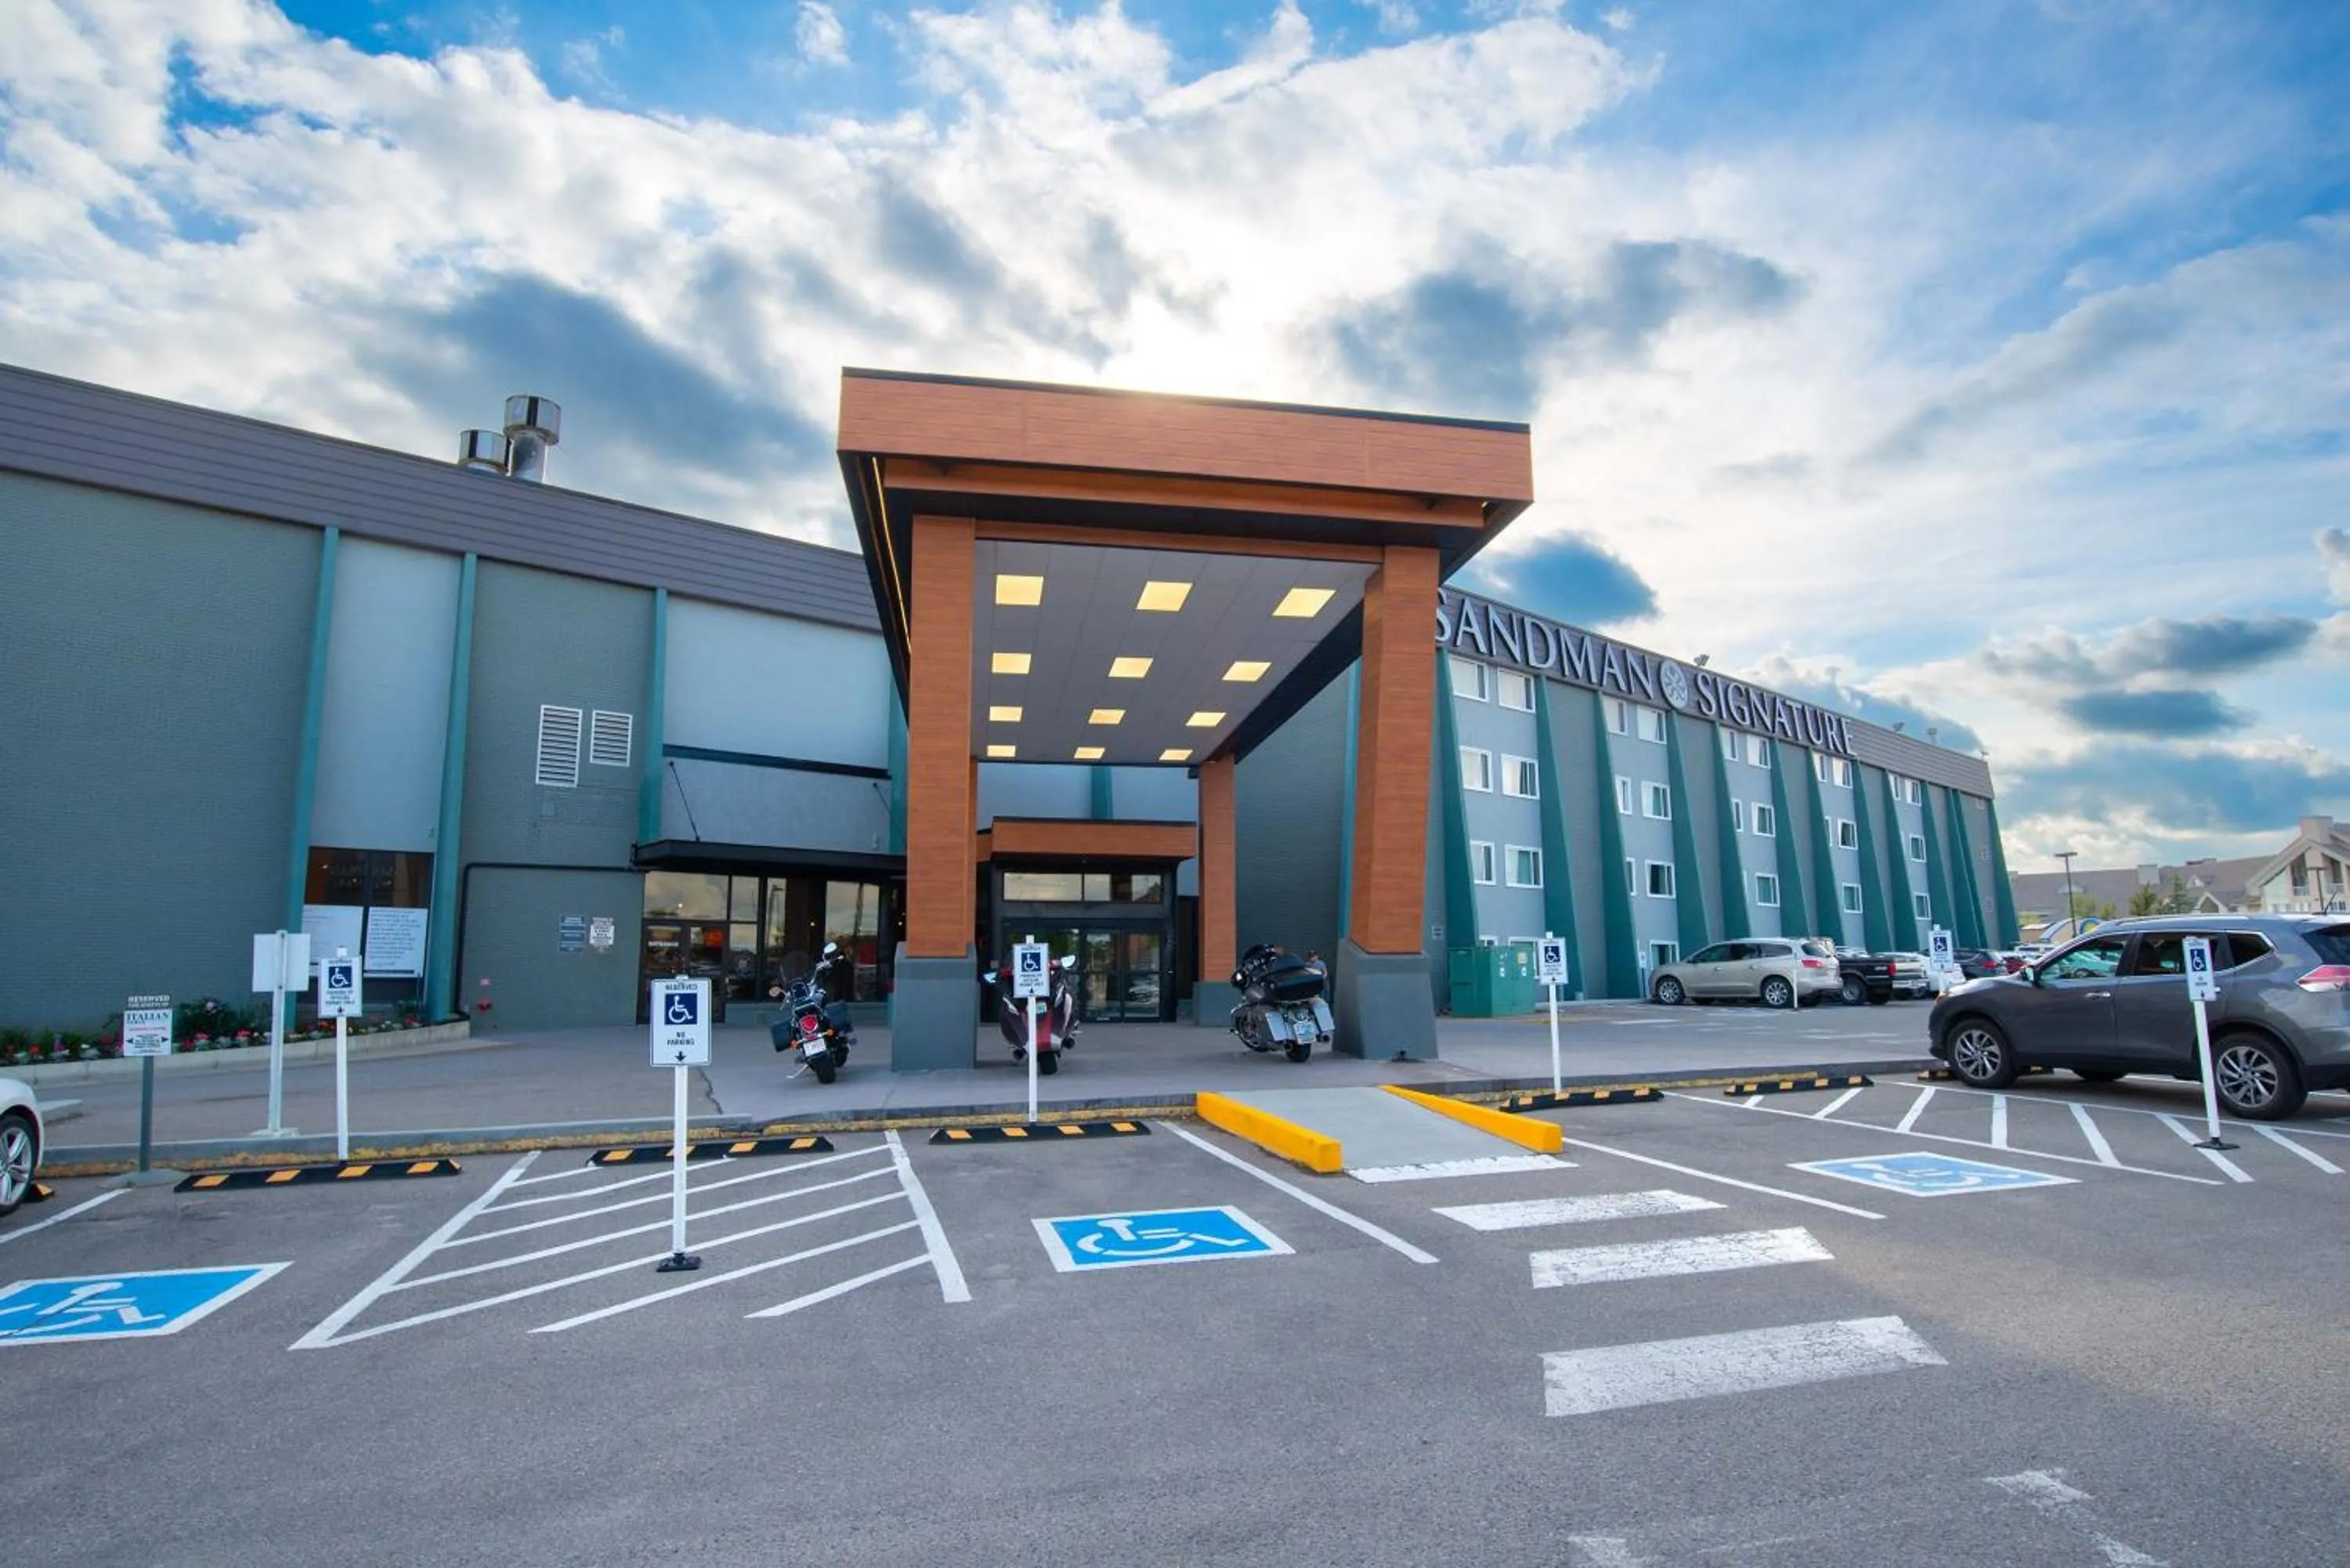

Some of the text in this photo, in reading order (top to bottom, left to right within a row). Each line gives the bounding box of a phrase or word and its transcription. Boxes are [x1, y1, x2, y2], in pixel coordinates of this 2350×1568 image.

[1436, 587, 1858, 757] SANDMAN SIGNATURE
[126, 1012, 169, 1021] ITALIAN
